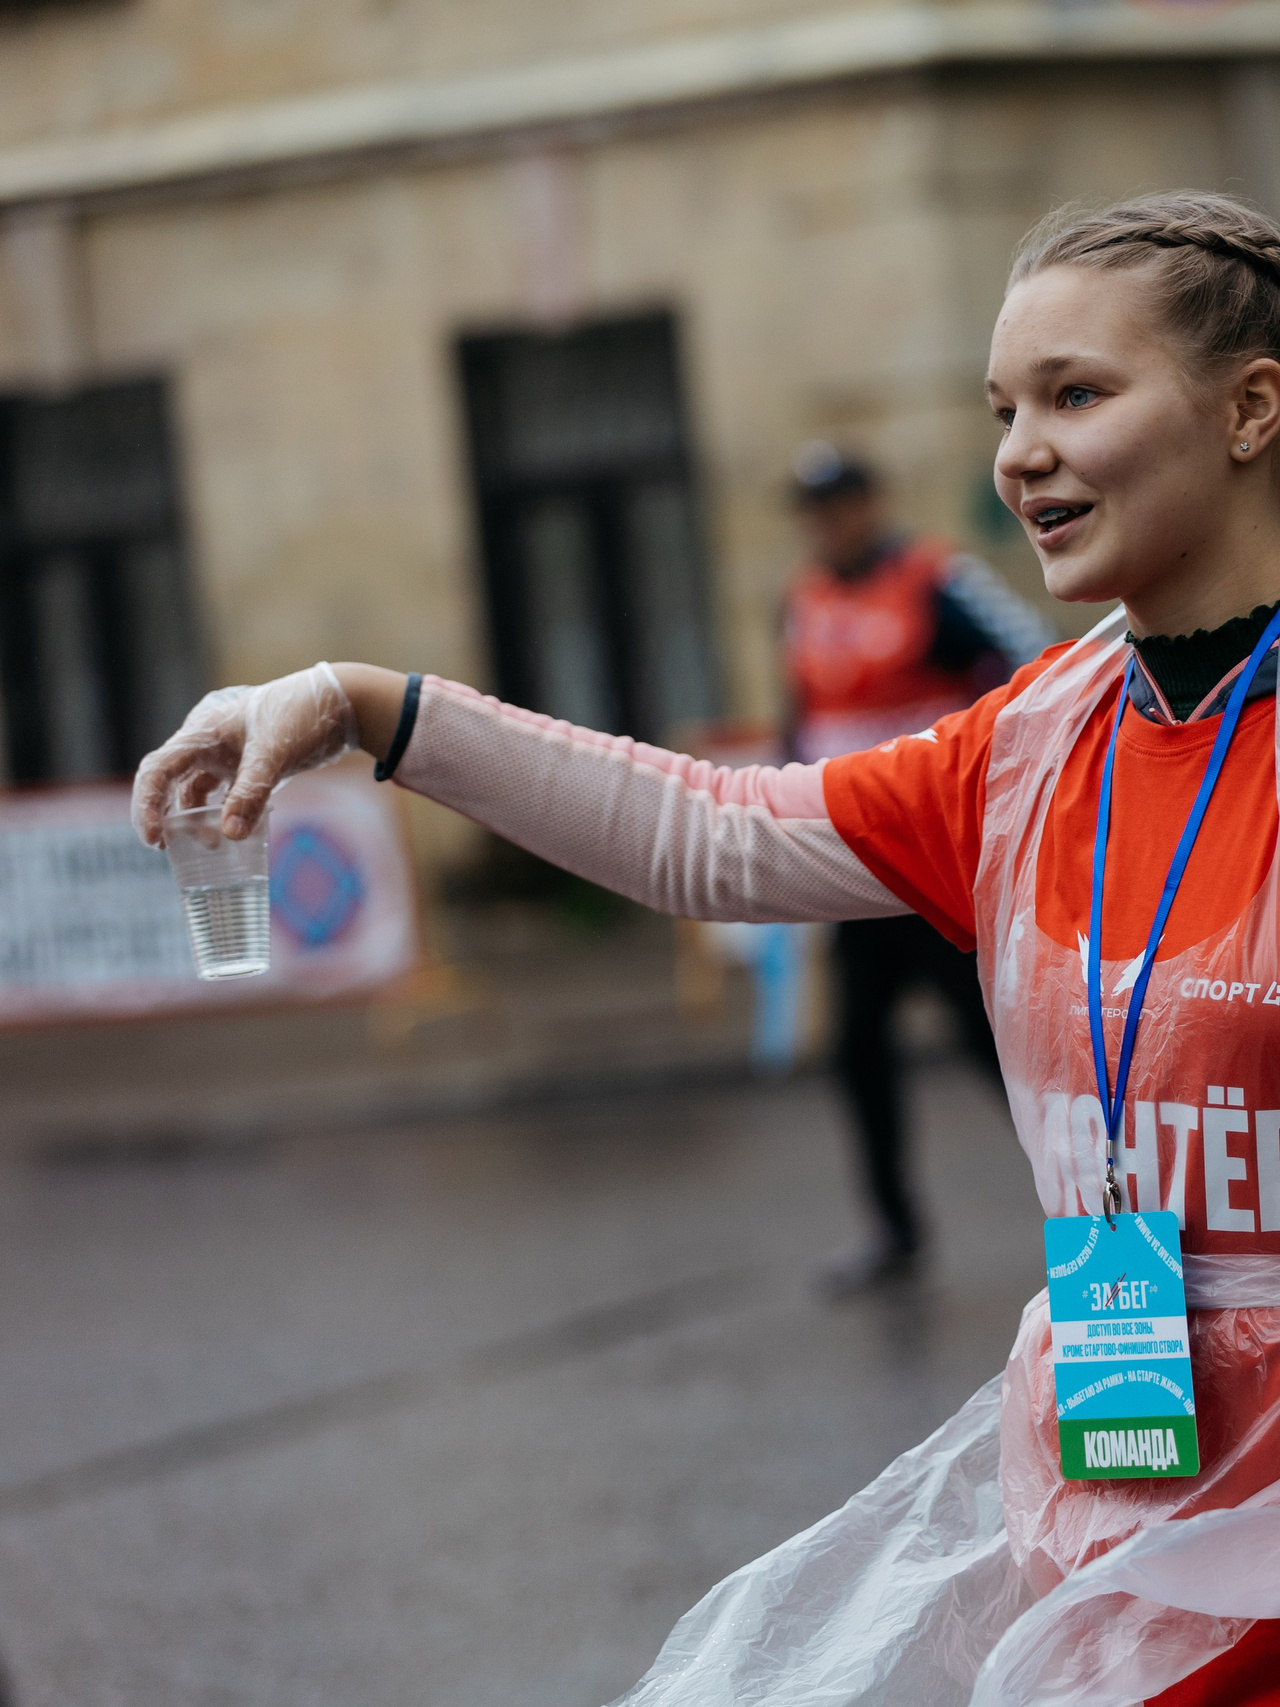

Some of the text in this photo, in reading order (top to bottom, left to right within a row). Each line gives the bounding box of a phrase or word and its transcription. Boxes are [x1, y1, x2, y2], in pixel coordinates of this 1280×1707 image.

[1180, 977, 1261, 1003] СПОРТ
[1087, 1323, 1112, 1338] ДОСТУП
[1112, 1323, 1121, 1336] ВО
[1122, 1322, 1134, 1335] ВСЕ
[1062, 1340, 1184, 1358] КРОМЕ СТАРТОВО-ФИНИШНОГО СТВОРА
[1066, 1387, 1095, 1410] ВЫБЕГАЮ
[1094, 1381, 1104, 1394] ЗА
[1101, 1372, 1125, 1390] РАМКИ
[1127, 1370, 1137, 1382] НА
[1137, 1369, 1160, 1385] СТАРТЕ
[1160, 1375, 1184, 1400] ЖИЗНИ
[1083, 1428, 1180, 1471] КОМАНДА
